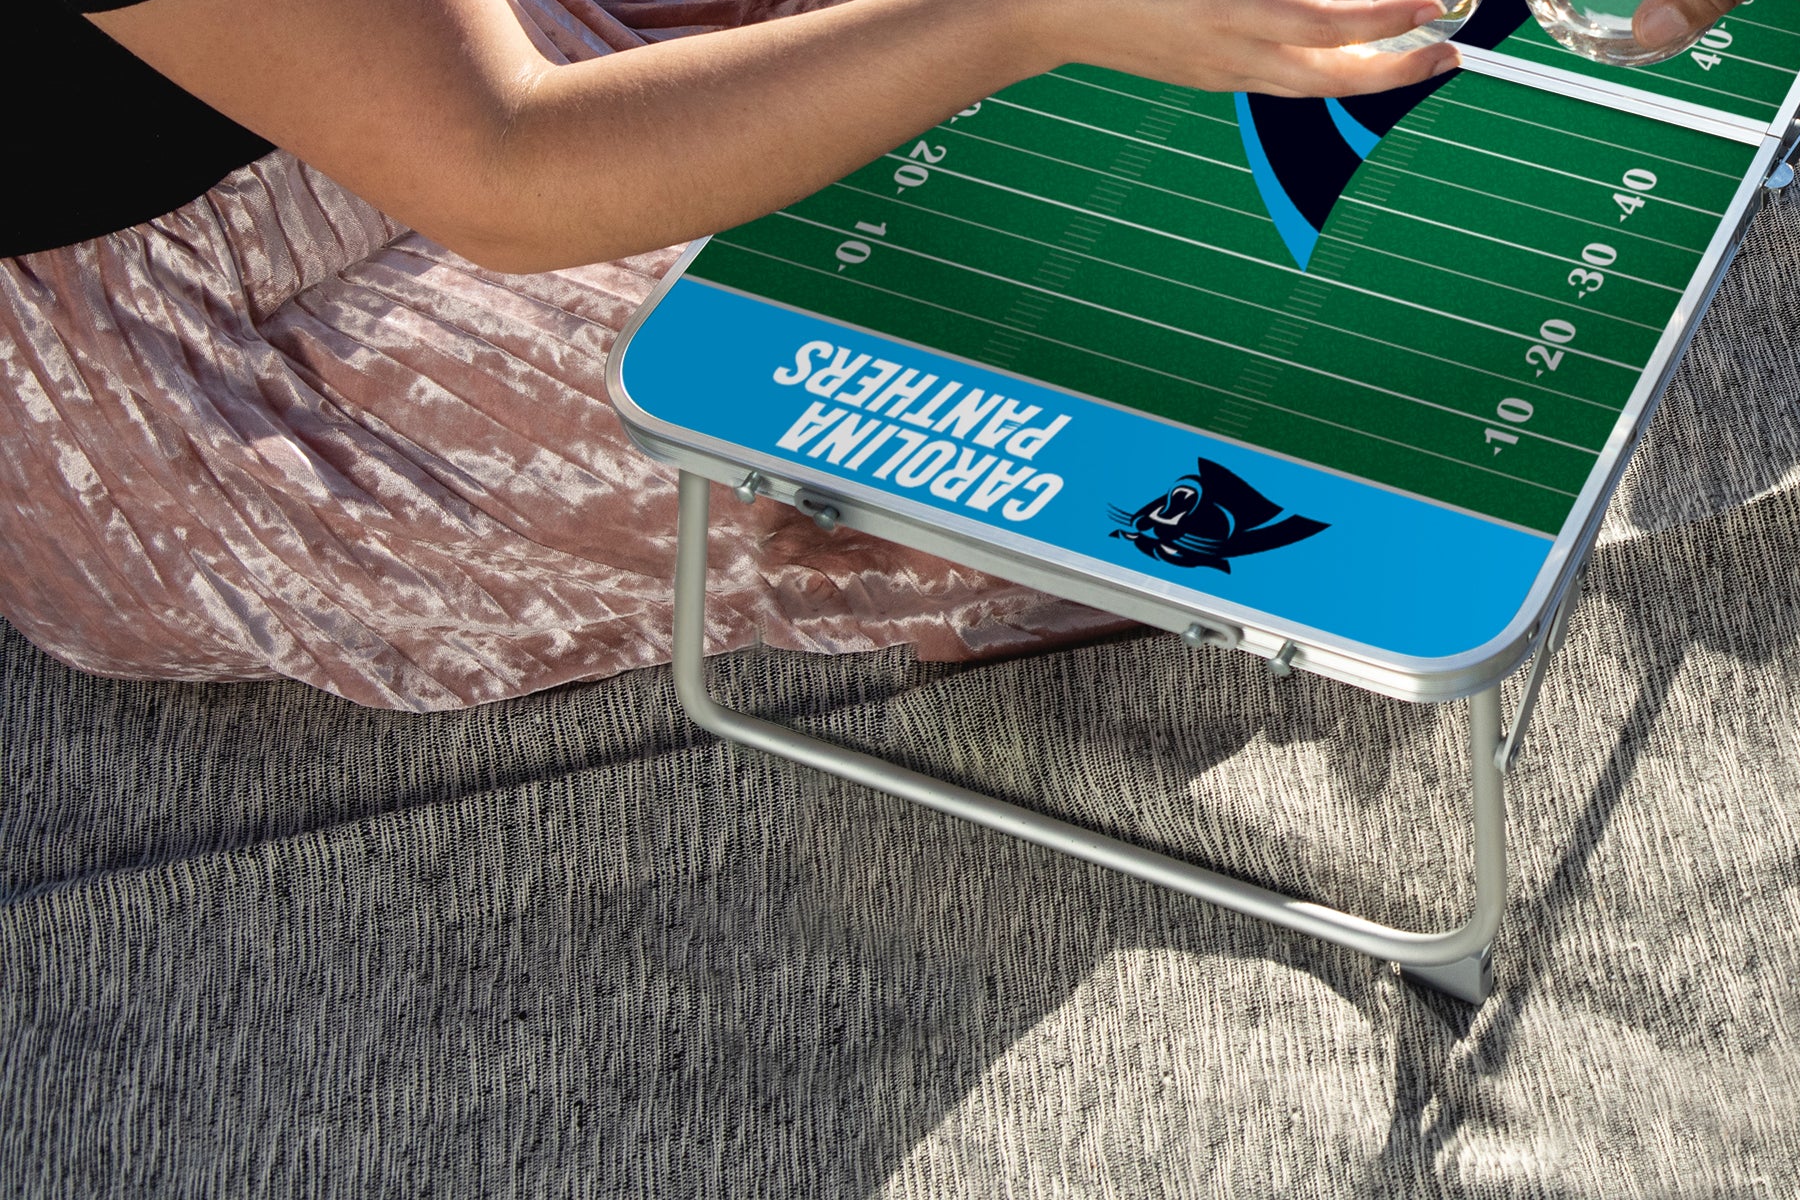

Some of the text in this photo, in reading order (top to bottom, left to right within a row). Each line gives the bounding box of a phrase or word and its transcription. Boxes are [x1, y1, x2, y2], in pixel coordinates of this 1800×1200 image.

[1690, 28, 1733, 71] 40
[893, 140, 947, 187] 20
[1612, 168, 1658, 217] 40
[835, 221, 887, 264] 10
[1567, 242, 1618, 293] 30
[1525, 318, 1577, 372] 20
[773, 339, 1073, 461] PANTHERS
[1484, 397, 1534, 446] 10
[776, 400, 1065, 522] CAROLINA
